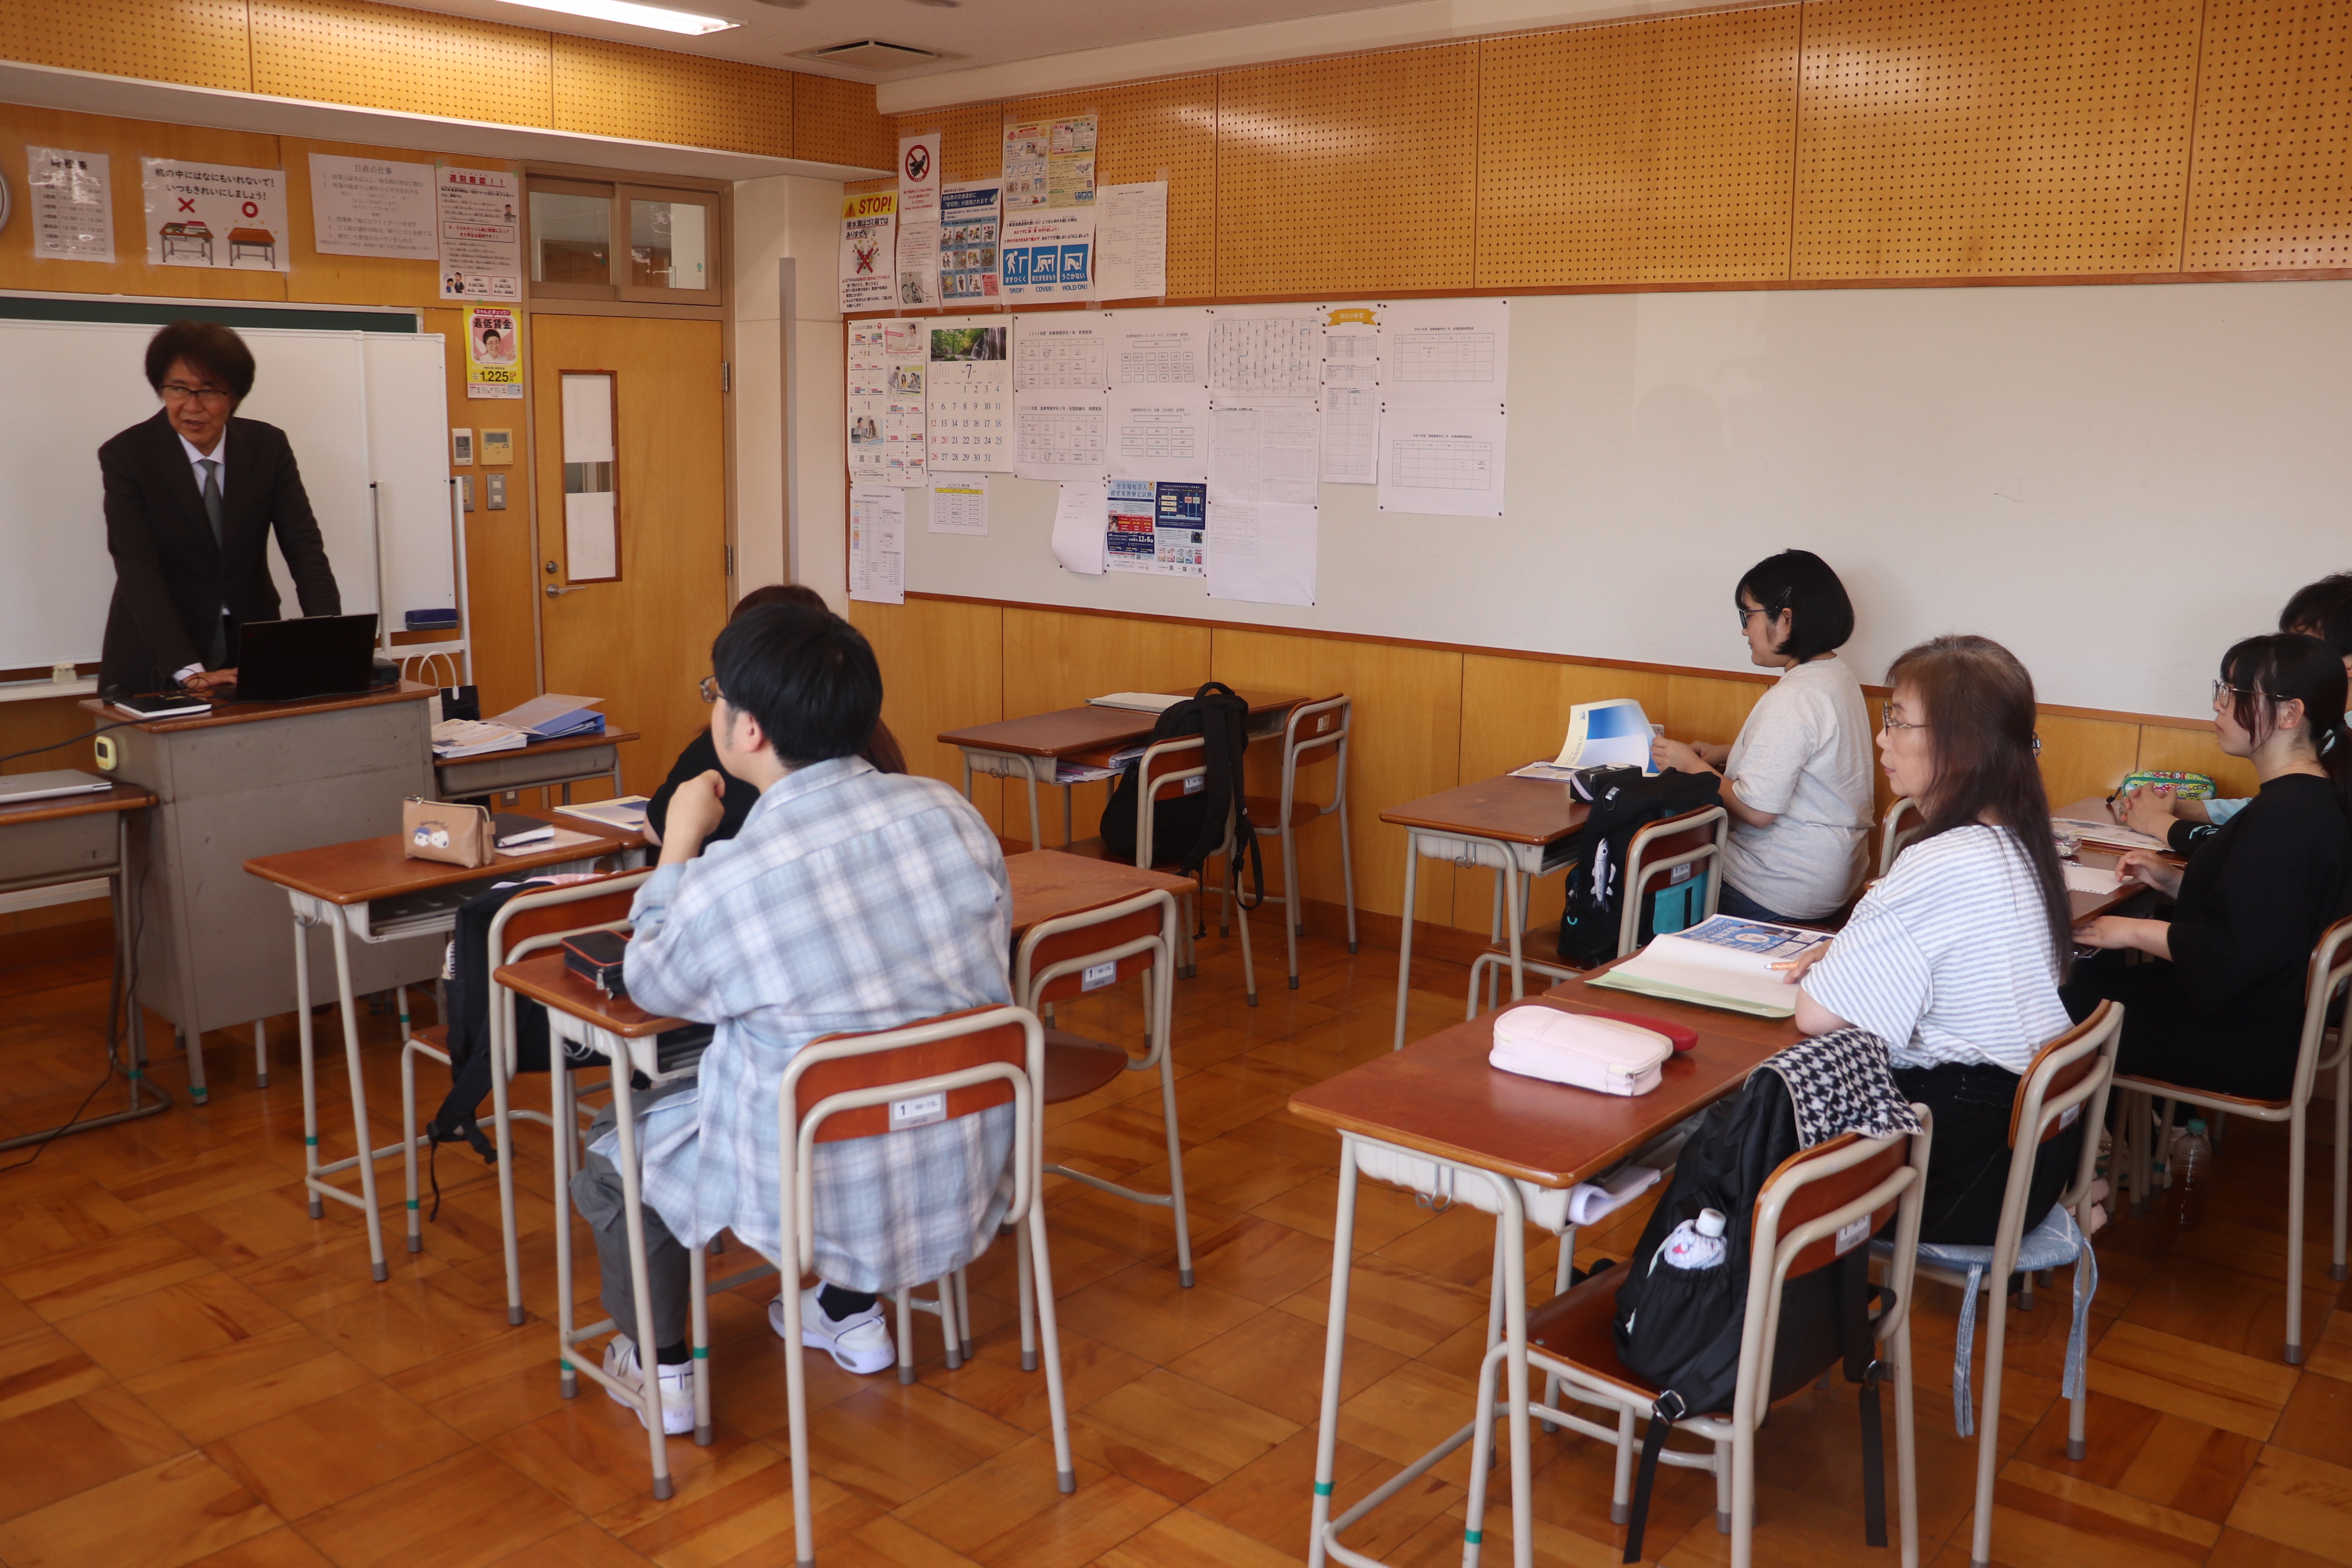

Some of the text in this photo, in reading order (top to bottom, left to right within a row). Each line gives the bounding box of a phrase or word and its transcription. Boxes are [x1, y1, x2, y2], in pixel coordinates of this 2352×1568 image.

[355, 165, 393, 175] 日直の仕事
[859, 195, 892, 214] STOP!
[847, 217, 889, 228] 排水溝はゴミ箱では
[846, 230, 868, 239] ありません
[474, 318, 512, 329] 最低賃金
[480, 371, 509, 382] 1,225
[966, 364, 972, 379] 7
[1089, 969, 1092, 978] 1
[901, 1105, 905, 1115] 1
